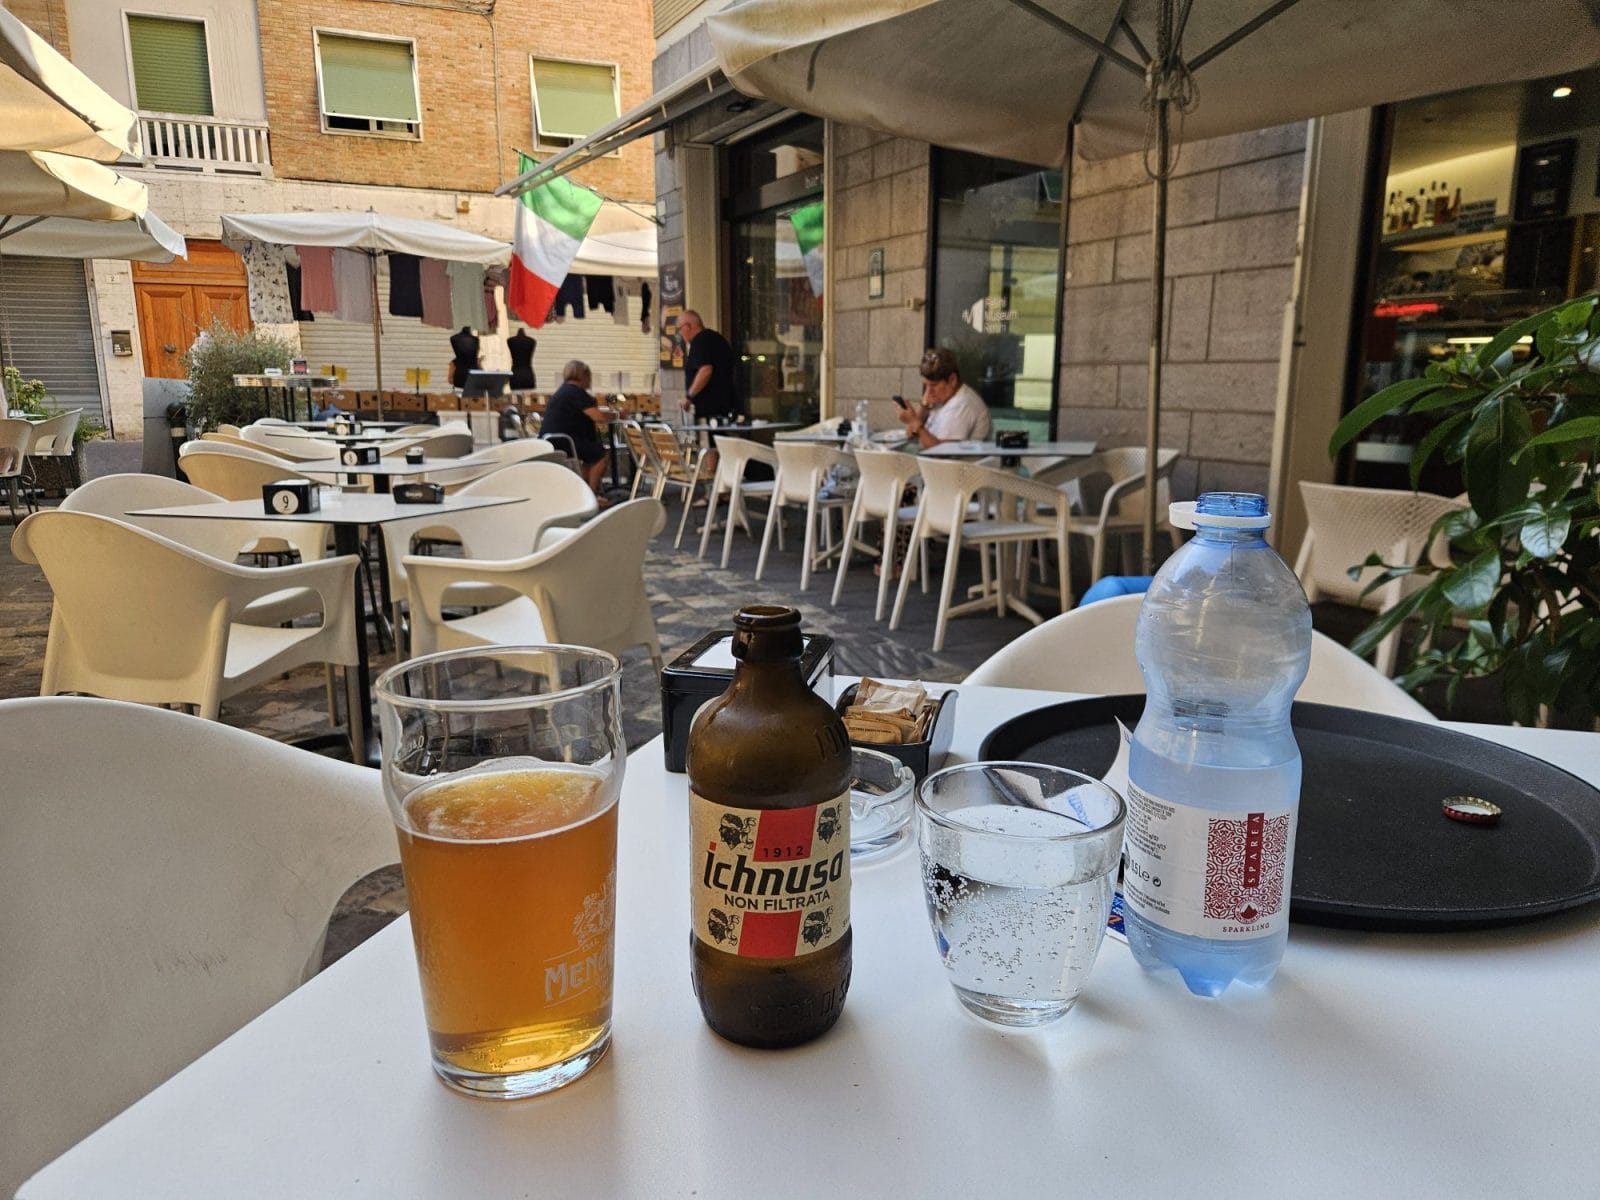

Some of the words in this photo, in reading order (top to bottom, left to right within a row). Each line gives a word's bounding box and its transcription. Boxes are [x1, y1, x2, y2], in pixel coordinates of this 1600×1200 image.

[281, 495, 289, 510] 9
[763, 845, 804, 859] 1912
[1248, 816, 1261, 886] SPAREA
[703, 841, 844, 896] ichnusa
[724, 894, 758, 911] NON
[763, 890, 831, 911] FILTRATA
[1222, 922, 1271, 933] SPARKLING
